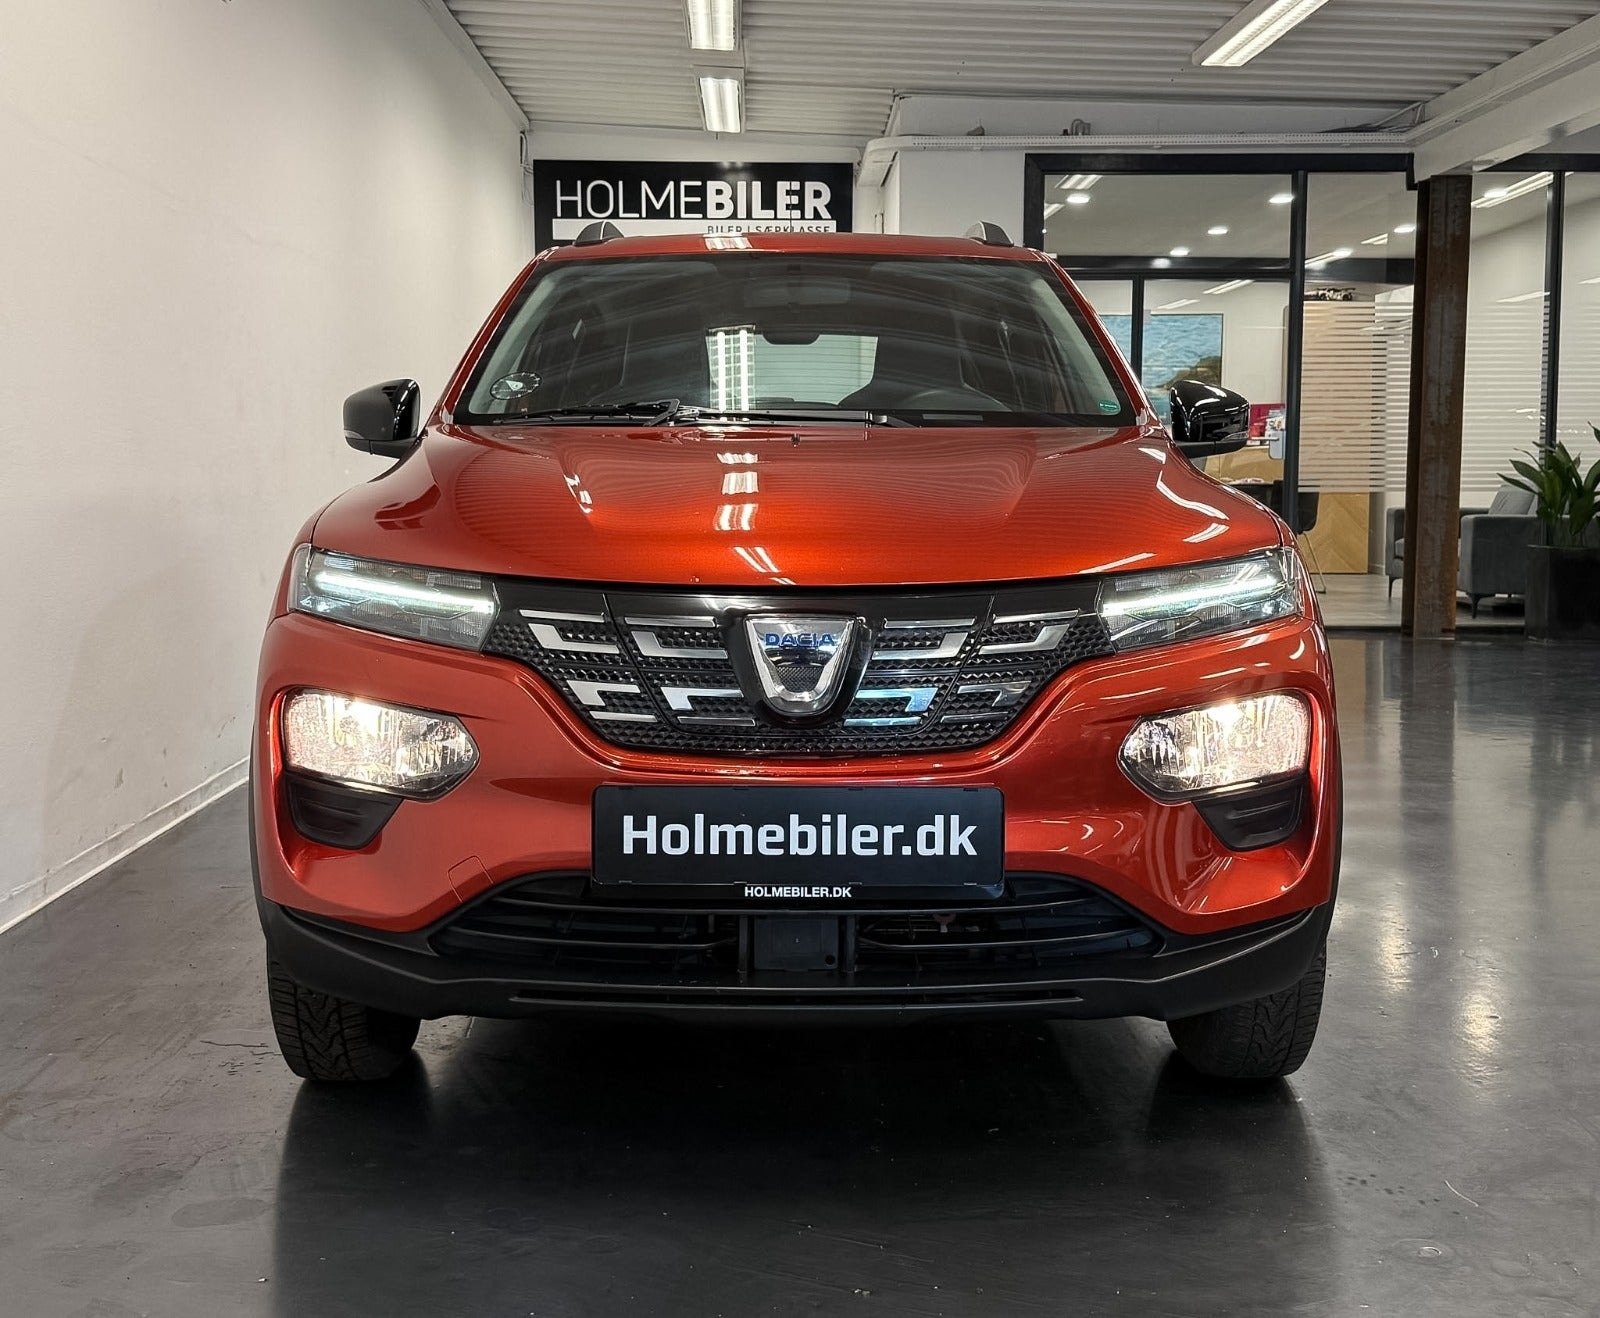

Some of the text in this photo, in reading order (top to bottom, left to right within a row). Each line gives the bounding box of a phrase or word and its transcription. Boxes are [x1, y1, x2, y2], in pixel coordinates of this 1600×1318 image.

[556, 180, 832, 219] HOLMEBILER
[765, 633, 835, 648] DACIA
[623, 813, 978, 856] Holmebiler.dk
[744, 886, 852, 898] HOLMEBILER.DK
